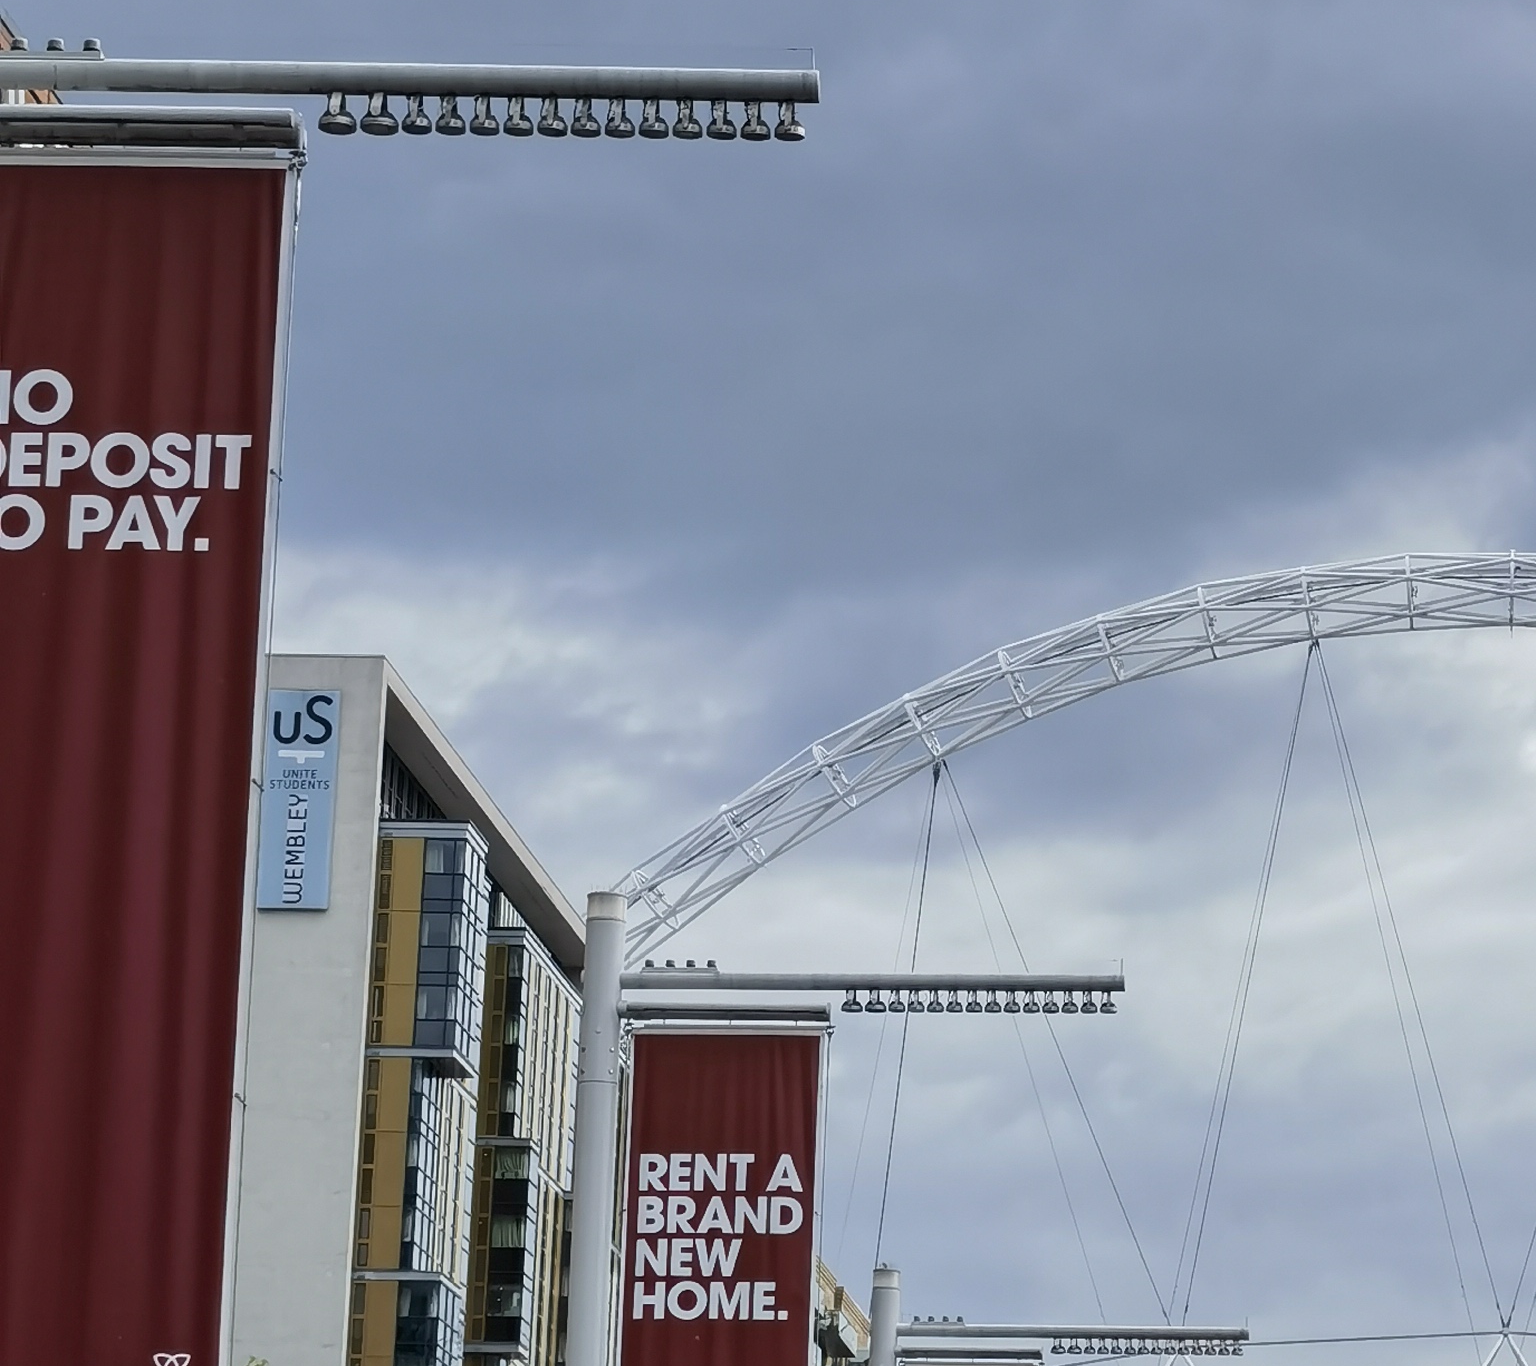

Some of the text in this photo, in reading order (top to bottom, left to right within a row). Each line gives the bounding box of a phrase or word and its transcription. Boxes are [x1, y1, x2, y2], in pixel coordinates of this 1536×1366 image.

[0, 369, 73, 425] O
[0, 432, 252, 489] EPOSIT
[67, 494, 209, 551] PAY.
[269, 779, 329, 790] STUDENTS
[282, 769, 317, 779] UNITE
[282, 794, 308, 904] WEMBLEY
[638, 1153, 803, 1192] RENT A
[637, 1196, 804, 1234] BRAND
[634, 1238, 742, 1277] NEW
[632, 1280, 788, 1321] HOME.
